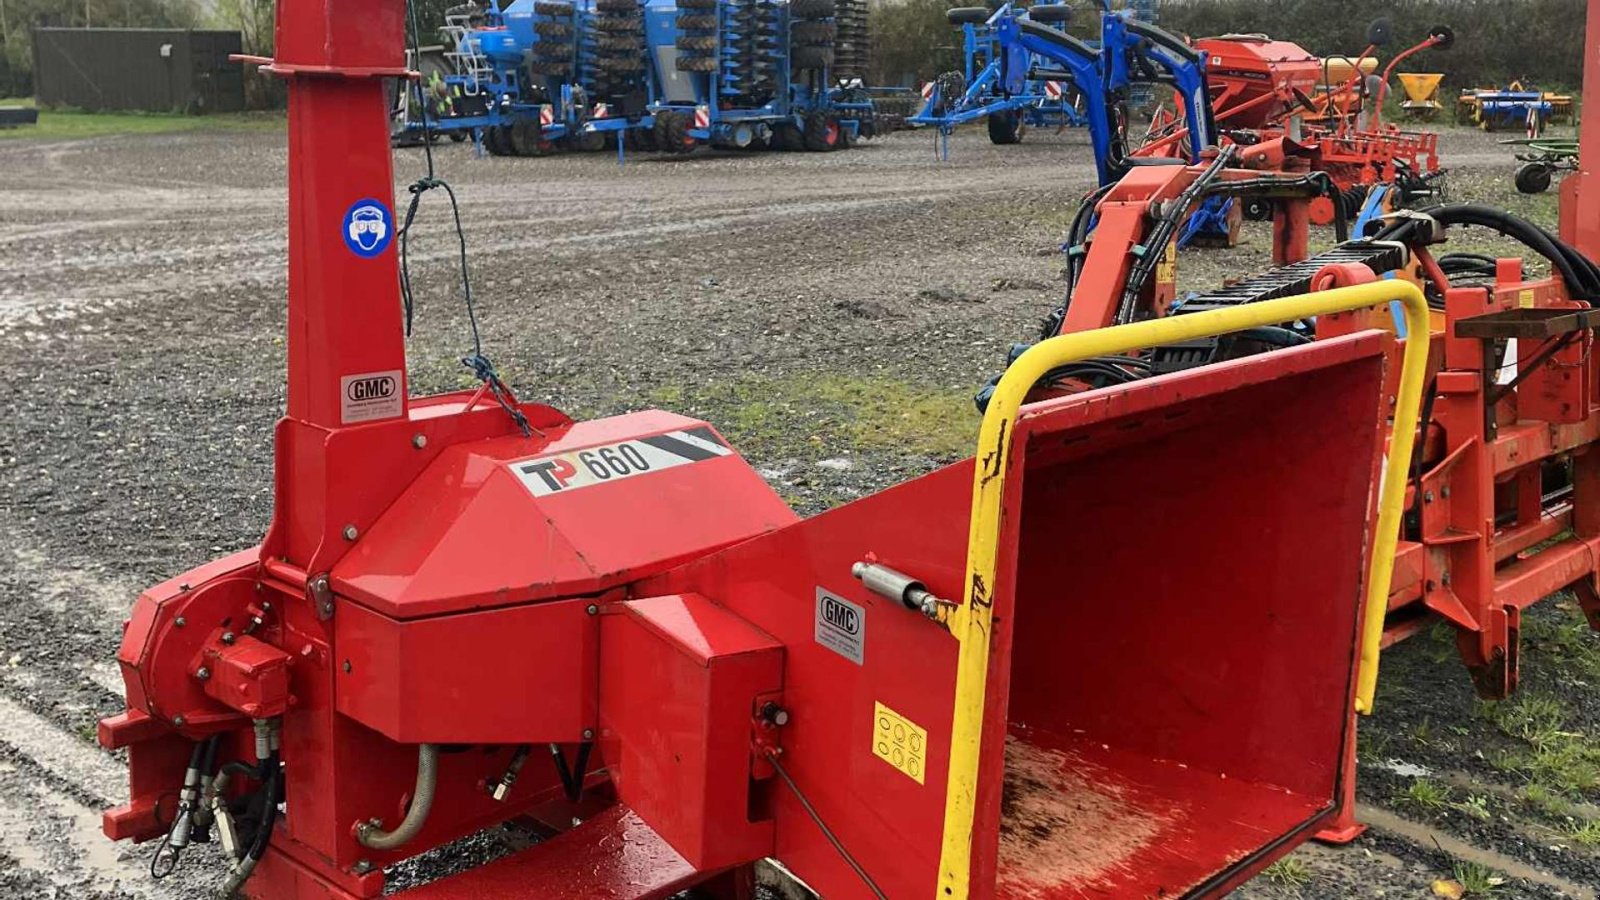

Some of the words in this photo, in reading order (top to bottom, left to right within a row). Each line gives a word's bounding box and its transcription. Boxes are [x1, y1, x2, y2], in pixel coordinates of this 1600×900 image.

[354, 378, 389, 399] GMC
[520, 458, 577, 491] TP
[578, 443, 650, 480] 660
[826, 600, 854, 632] GMC
